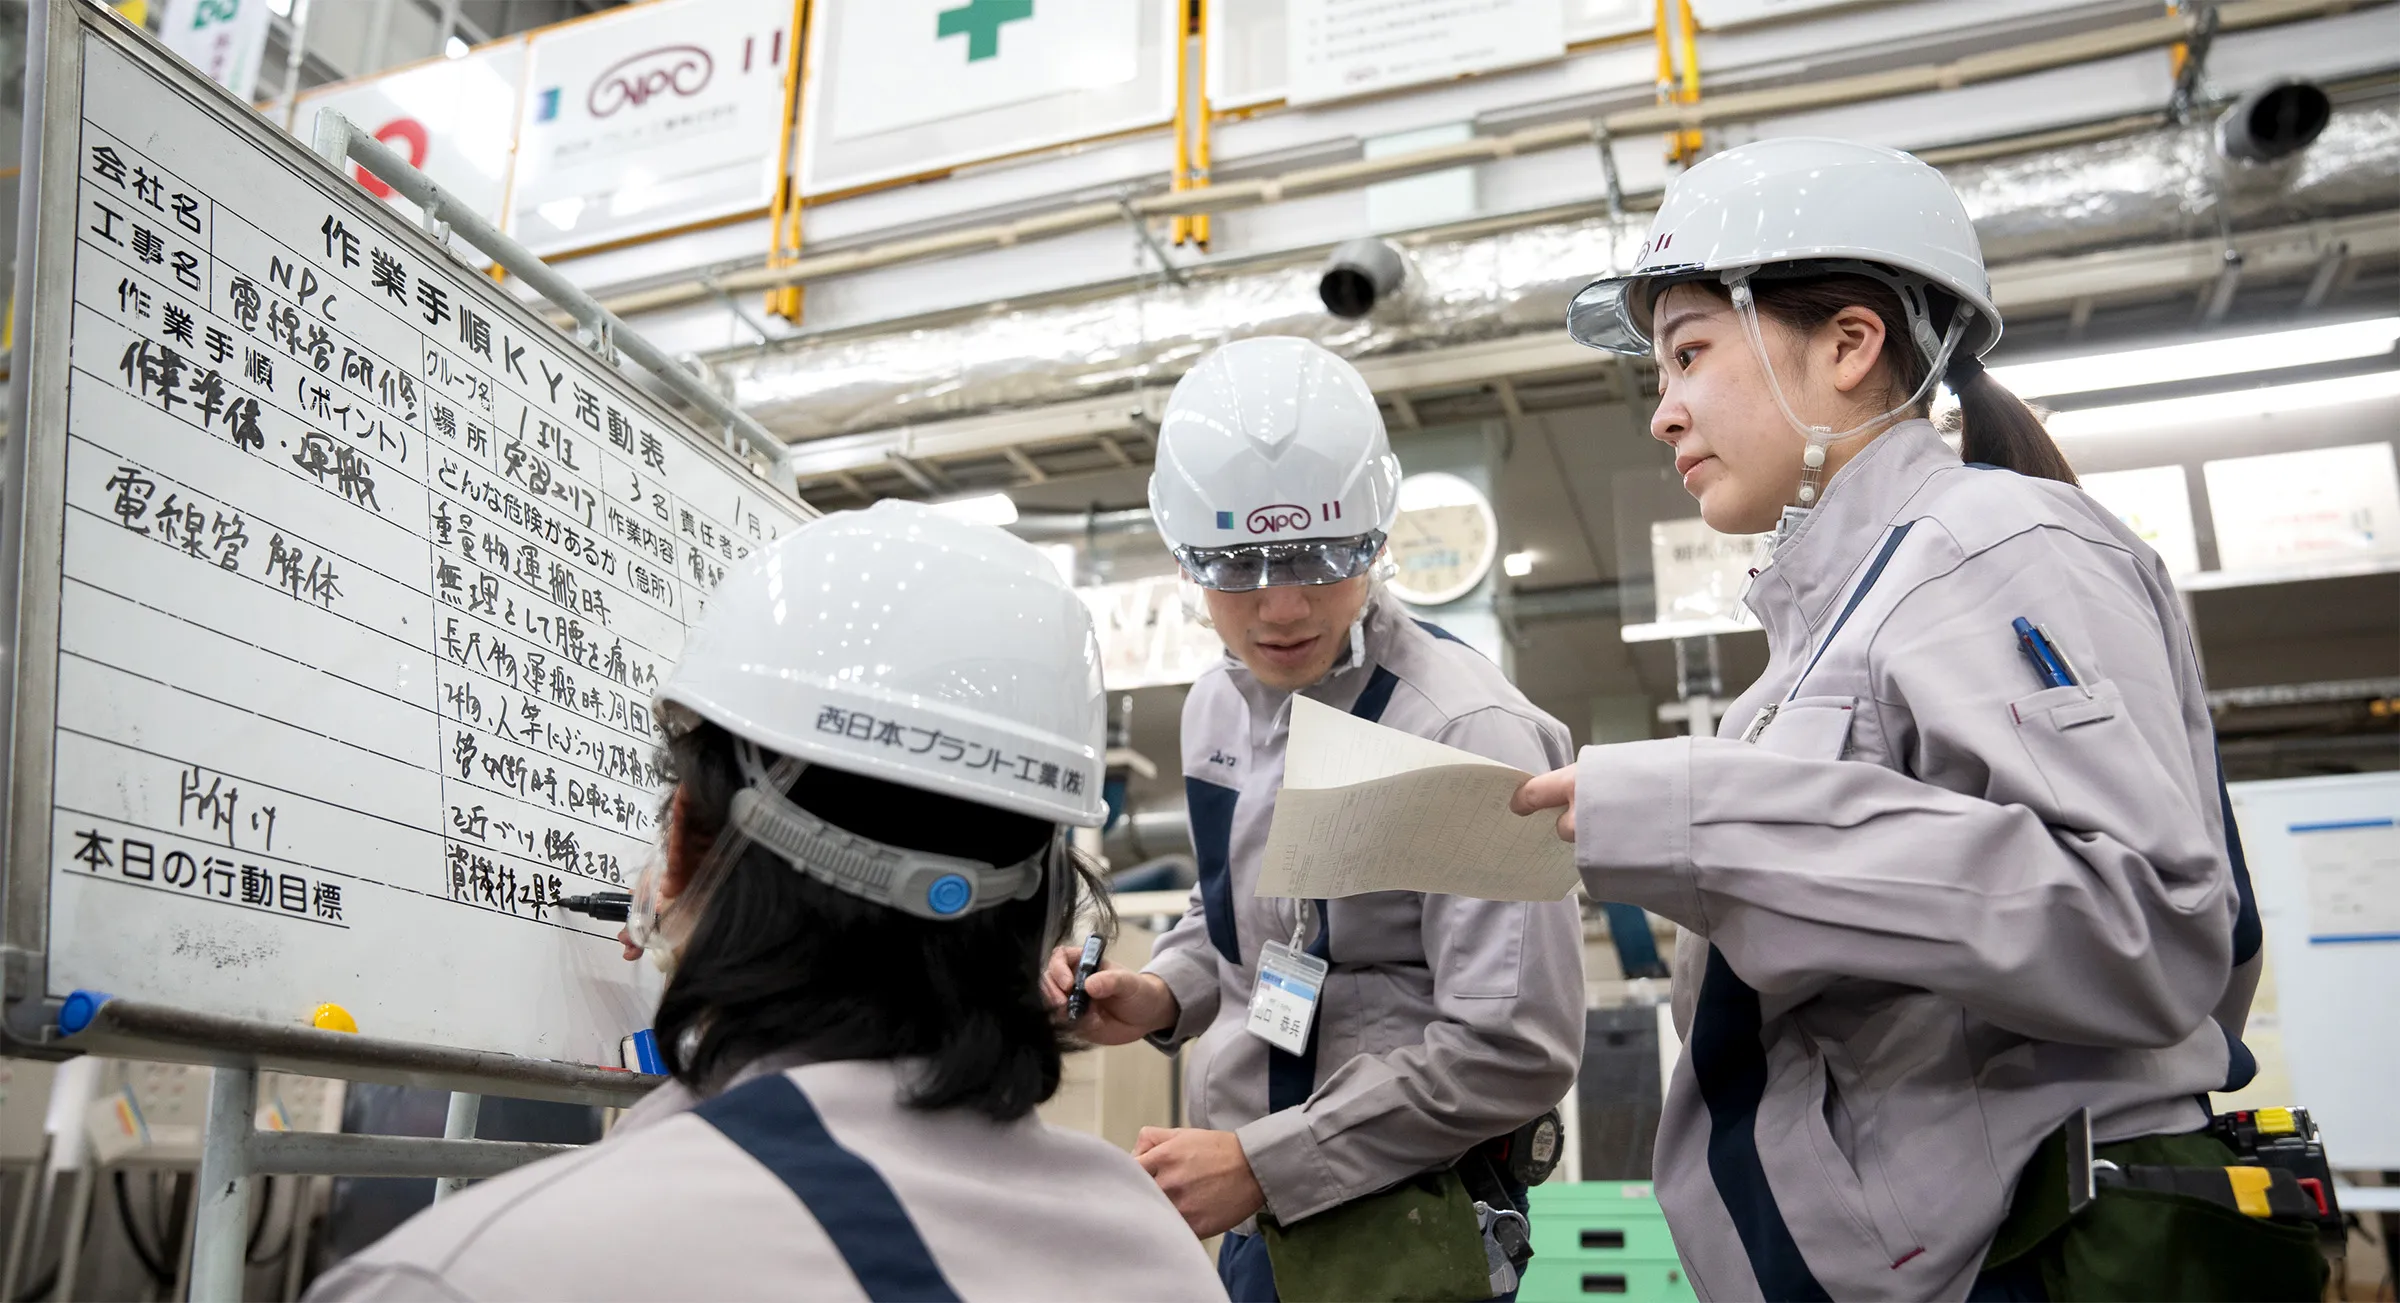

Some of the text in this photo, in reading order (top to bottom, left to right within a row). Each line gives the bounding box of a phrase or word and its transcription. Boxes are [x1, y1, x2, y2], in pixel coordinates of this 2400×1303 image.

[91, 146, 201, 234] 会社名
[91, 201, 201, 292] 工事名
[269, 255, 338, 322] NPC
[426, 350, 491, 411] グループ名
[430, 402, 488, 458] 場所
[608, 506, 675, 565] 作業内容
[74, 828, 343, 921] 本日の行動目標
